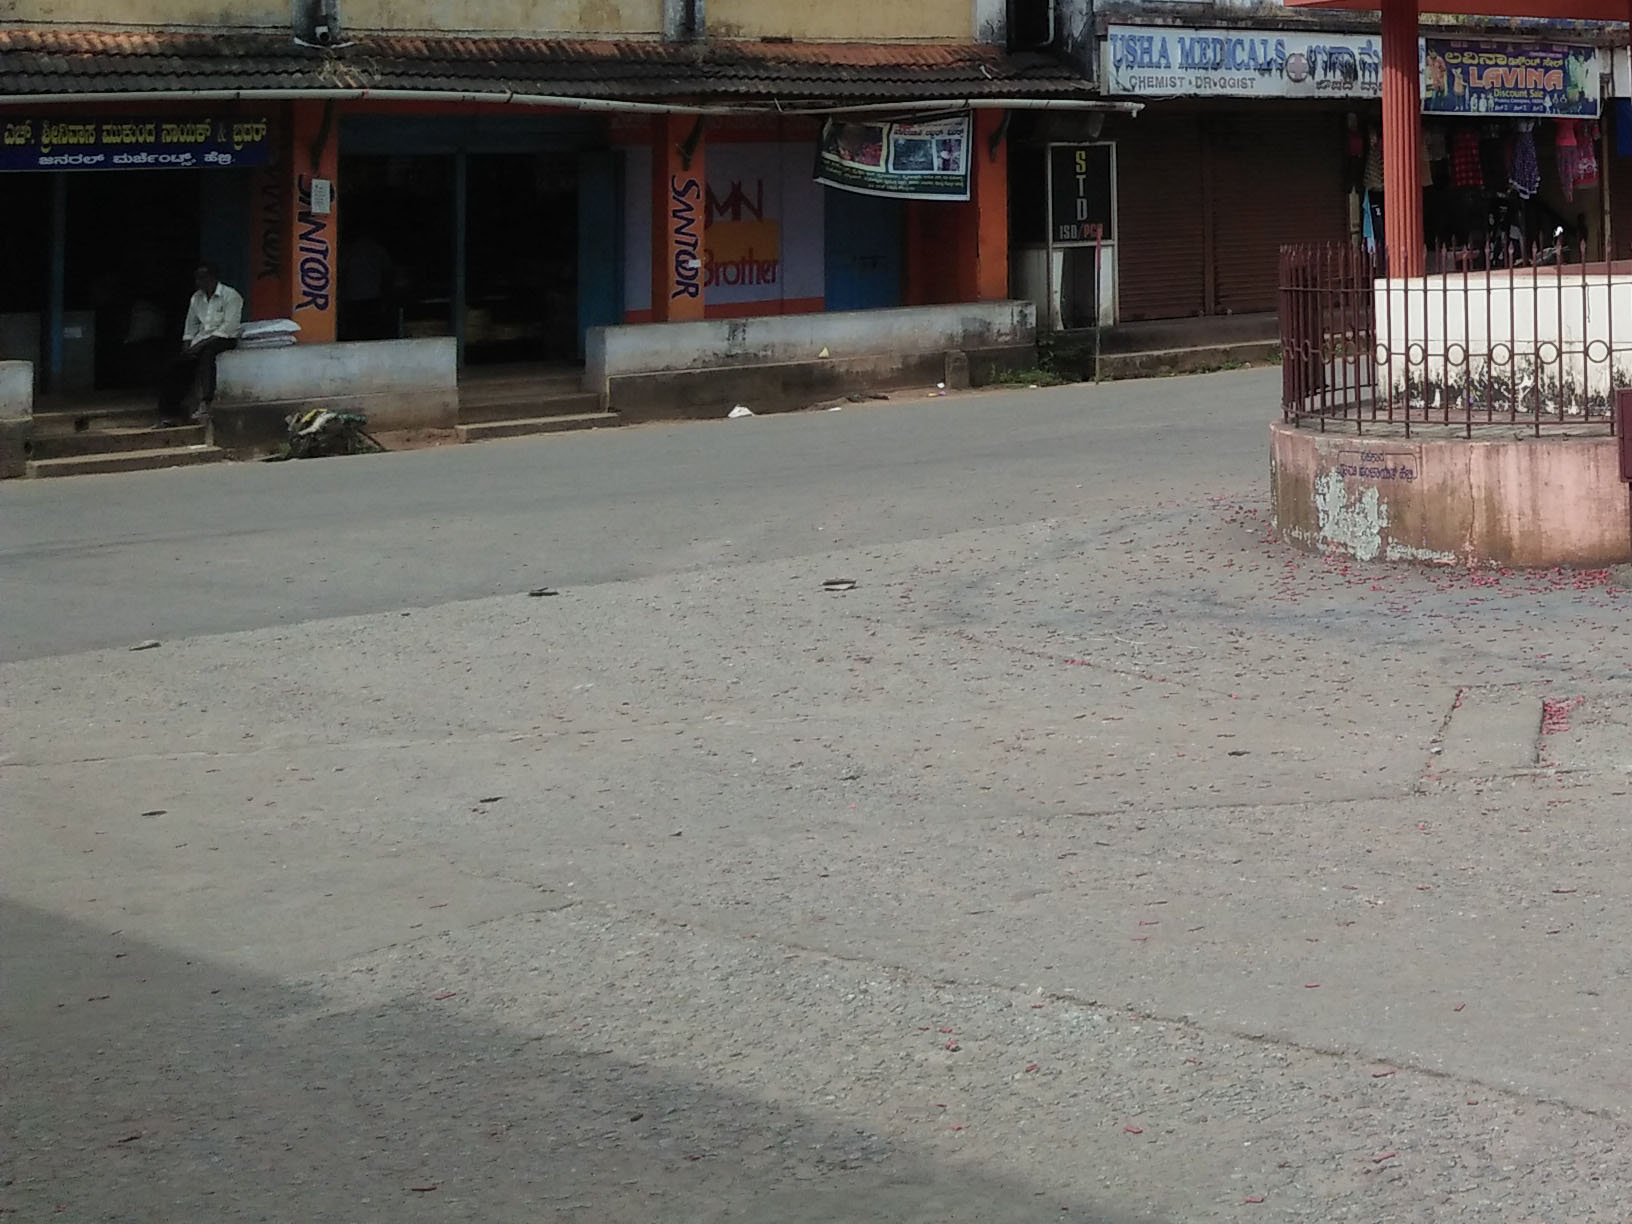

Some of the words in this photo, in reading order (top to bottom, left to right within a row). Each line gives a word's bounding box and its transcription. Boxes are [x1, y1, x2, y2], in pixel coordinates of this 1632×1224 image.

[1110, 34, 1172, 70] USHA
[1178, 37, 1286, 73] MEDICALS
[1129, 76, 1186, 90] CHEMIST
[1468, 66, 1563, 91] LAVINA
[1493, 88, 1528, 98] Discount
